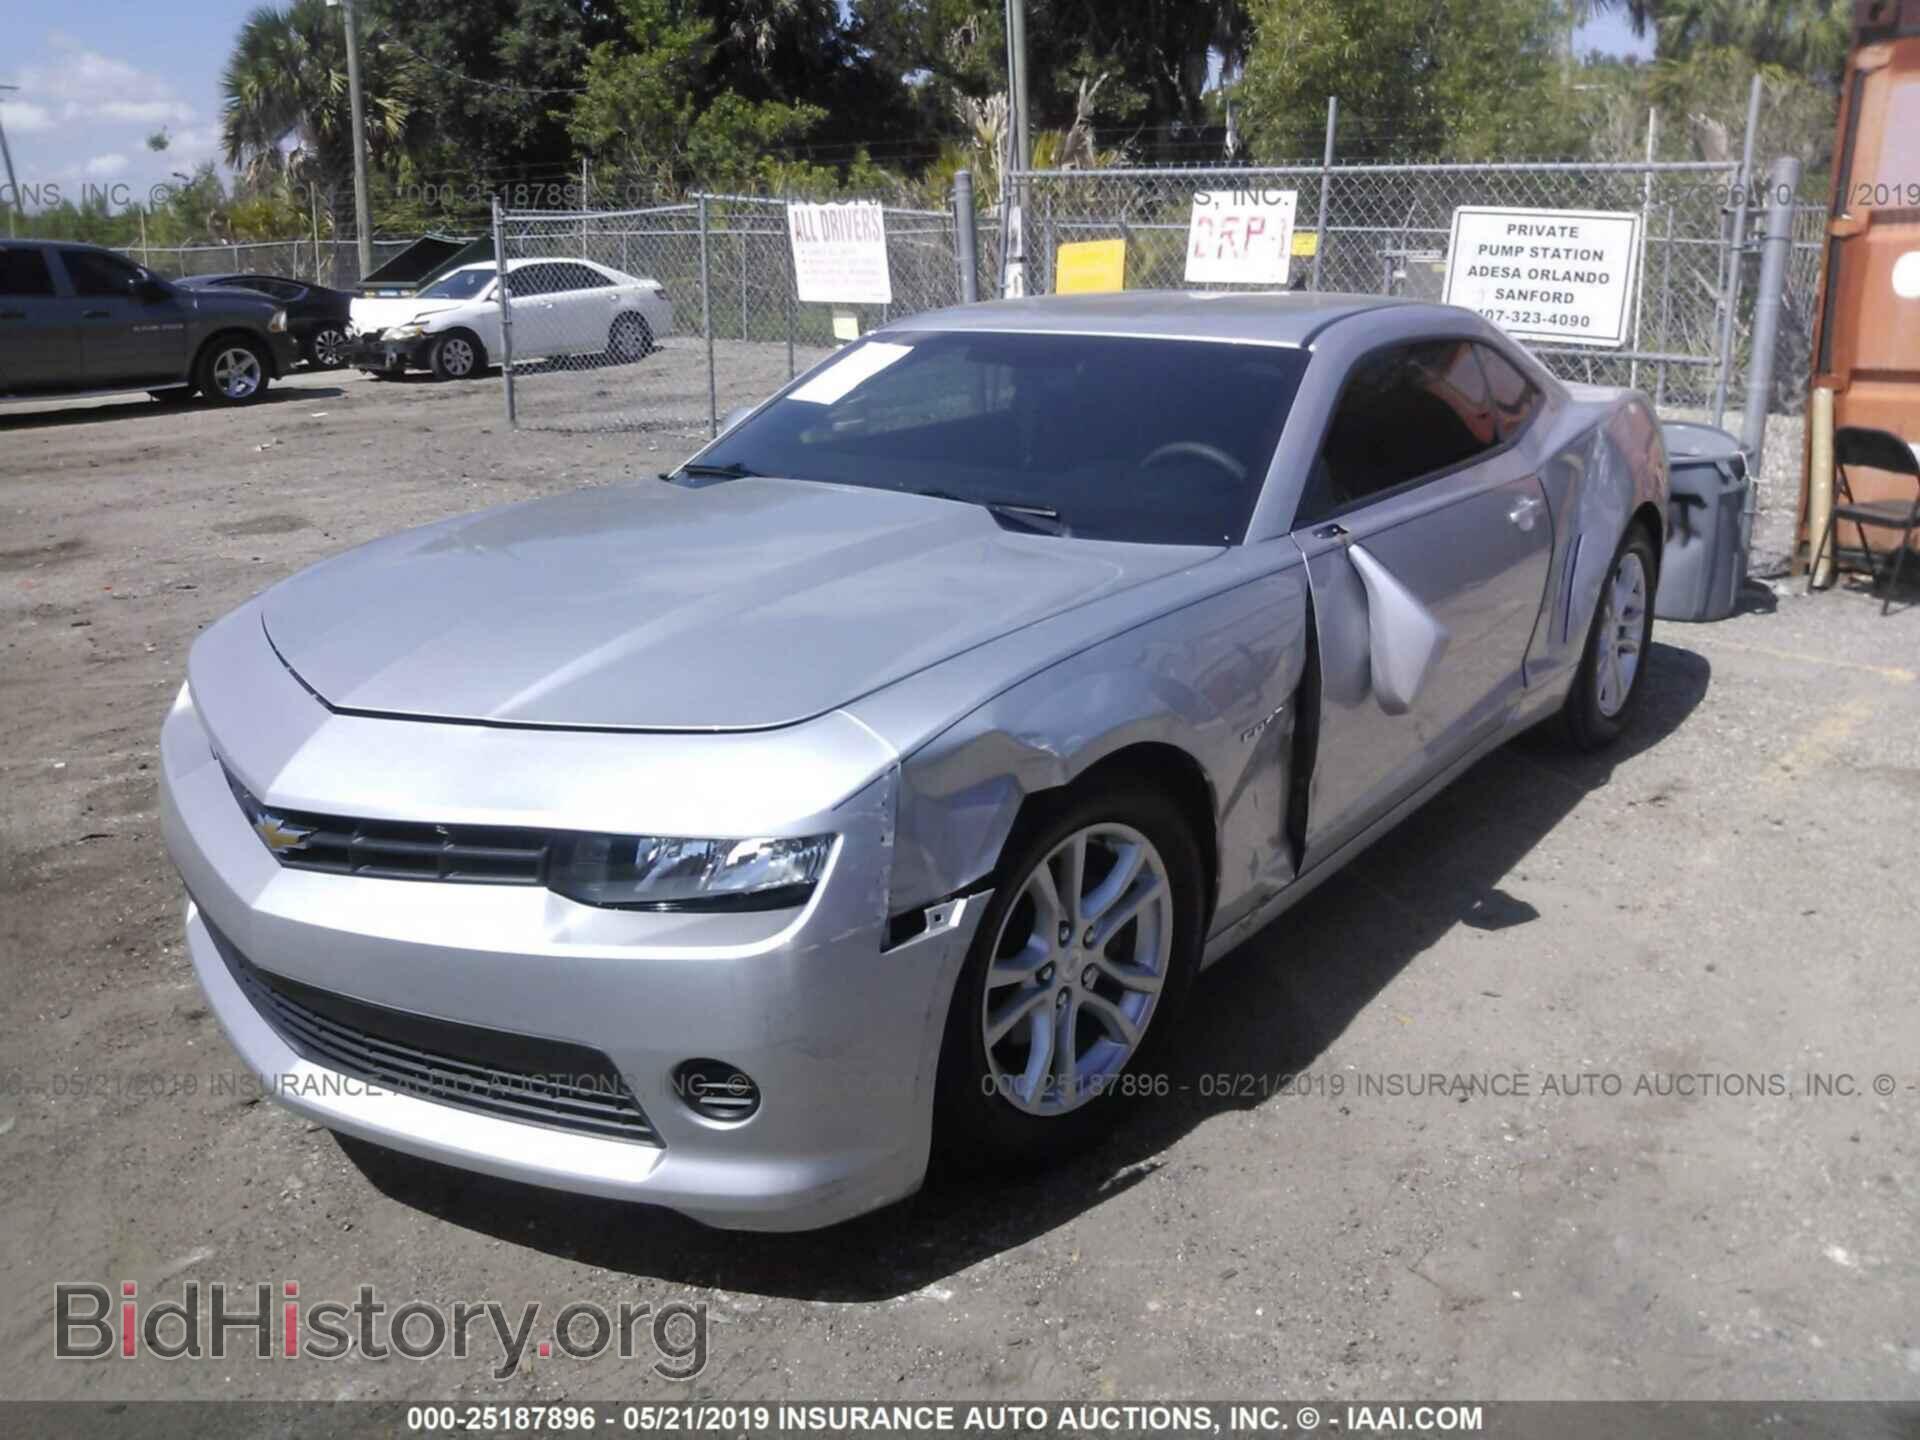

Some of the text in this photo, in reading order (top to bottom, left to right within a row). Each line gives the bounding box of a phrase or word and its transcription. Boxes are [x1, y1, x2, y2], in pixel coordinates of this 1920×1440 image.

[795, 207, 881, 242] ALL DRIVERS
[1506, 223, 1580, 239] PRIVATE
[1478, 243, 1604, 262] PUMP STATION
[1467, 265, 1611, 285] ADESA ORLANDO
[1495, 287, 1575, 305] SANFORD
[1479, 308, 1591, 328] 07-323-4090
